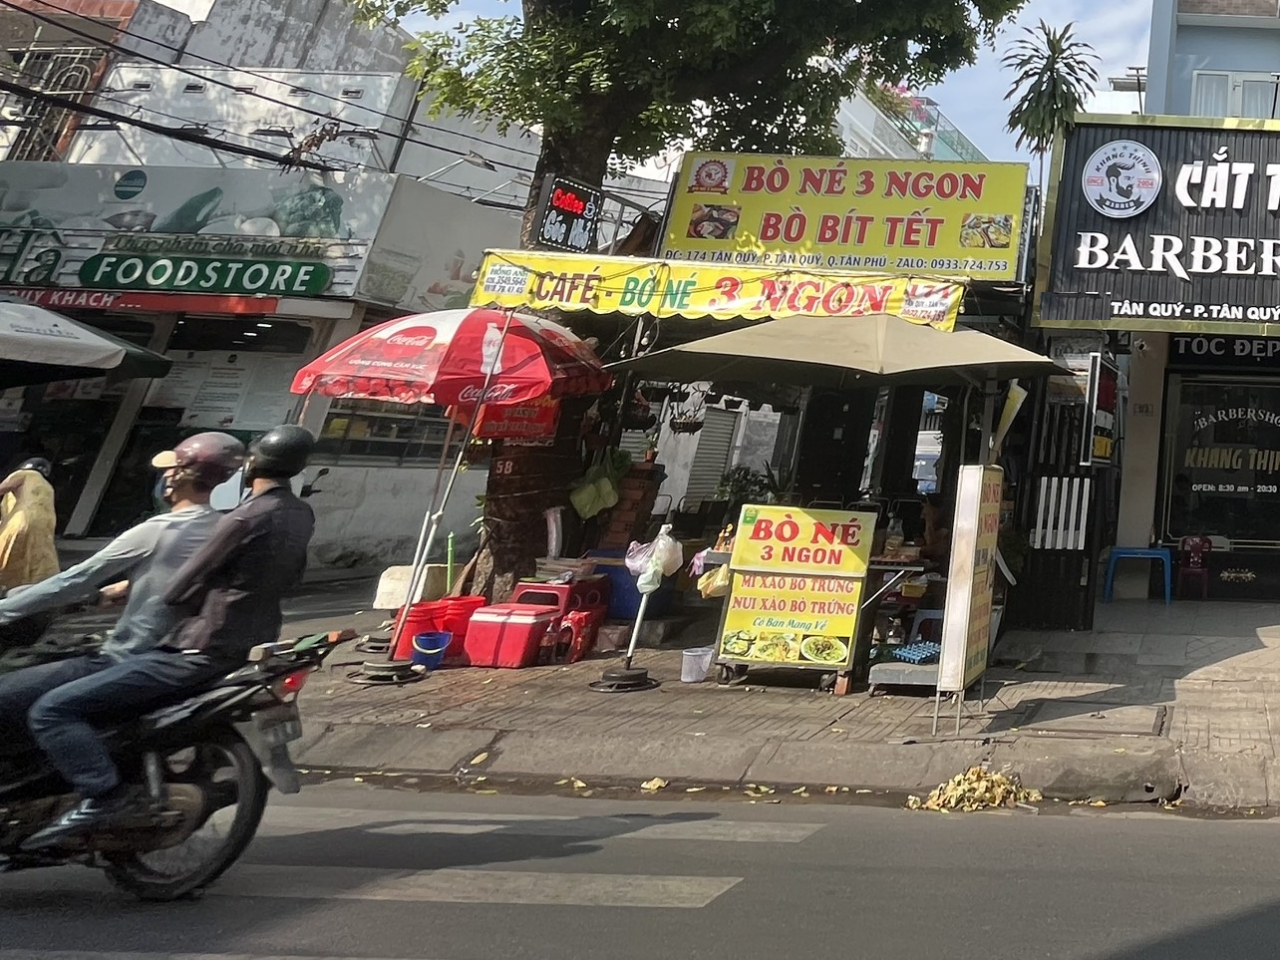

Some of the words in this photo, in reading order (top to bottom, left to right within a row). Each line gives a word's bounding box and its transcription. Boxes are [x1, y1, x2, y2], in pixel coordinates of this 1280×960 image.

[741, 158, 792, 194] BÒ
[799, 161, 848, 195] NÉ
[854, 169, 876, 196] 3
[884, 171, 987, 200] NGON
[1174, 146, 1256, 211] CẮT
[552, 188, 586, 216] Coffee
[543, 210, 567, 243] Góc
[567, 218, 590, 249] Nhỏ
[759, 206, 808, 243] BÒ
[817, 208, 875, 246] BÍT
[885, 208, 946, 247] TẾT
[94, 257, 315, 291] FOODSTORE
[664, 249, 683, 261] ĐC:
[686, 250, 707, 261] 174
[866, 253, 887, 268] PHÚ
[896, 256, 928, 270] ZALO:
[930, 257, 1009, 272] 0933.724.753
[535, 266, 602, 303] CAFÉ
[619, 268, 656, 308] BÒ
[661, 272, 697, 309] NÉ
[708, 276, 743, 312] 3
[750, 279, 893, 316] NGON
[1111, 300, 1144, 315] TÂN
[496, 461, 513, 474] 58
[1184, 447, 1242, 470] KHANG
[1192, 484, 1216, 492] OPEN:
[1257, 485, 1277, 493] 20:30
[749, 513, 800, 543] BÒ
[810, 517, 862, 547] NÉ
[760, 545, 774, 561] 3
[781, 546, 843, 565] NGON
[732, 596, 757, 609] NUI
[810, 598, 855, 616] TRỨNG
